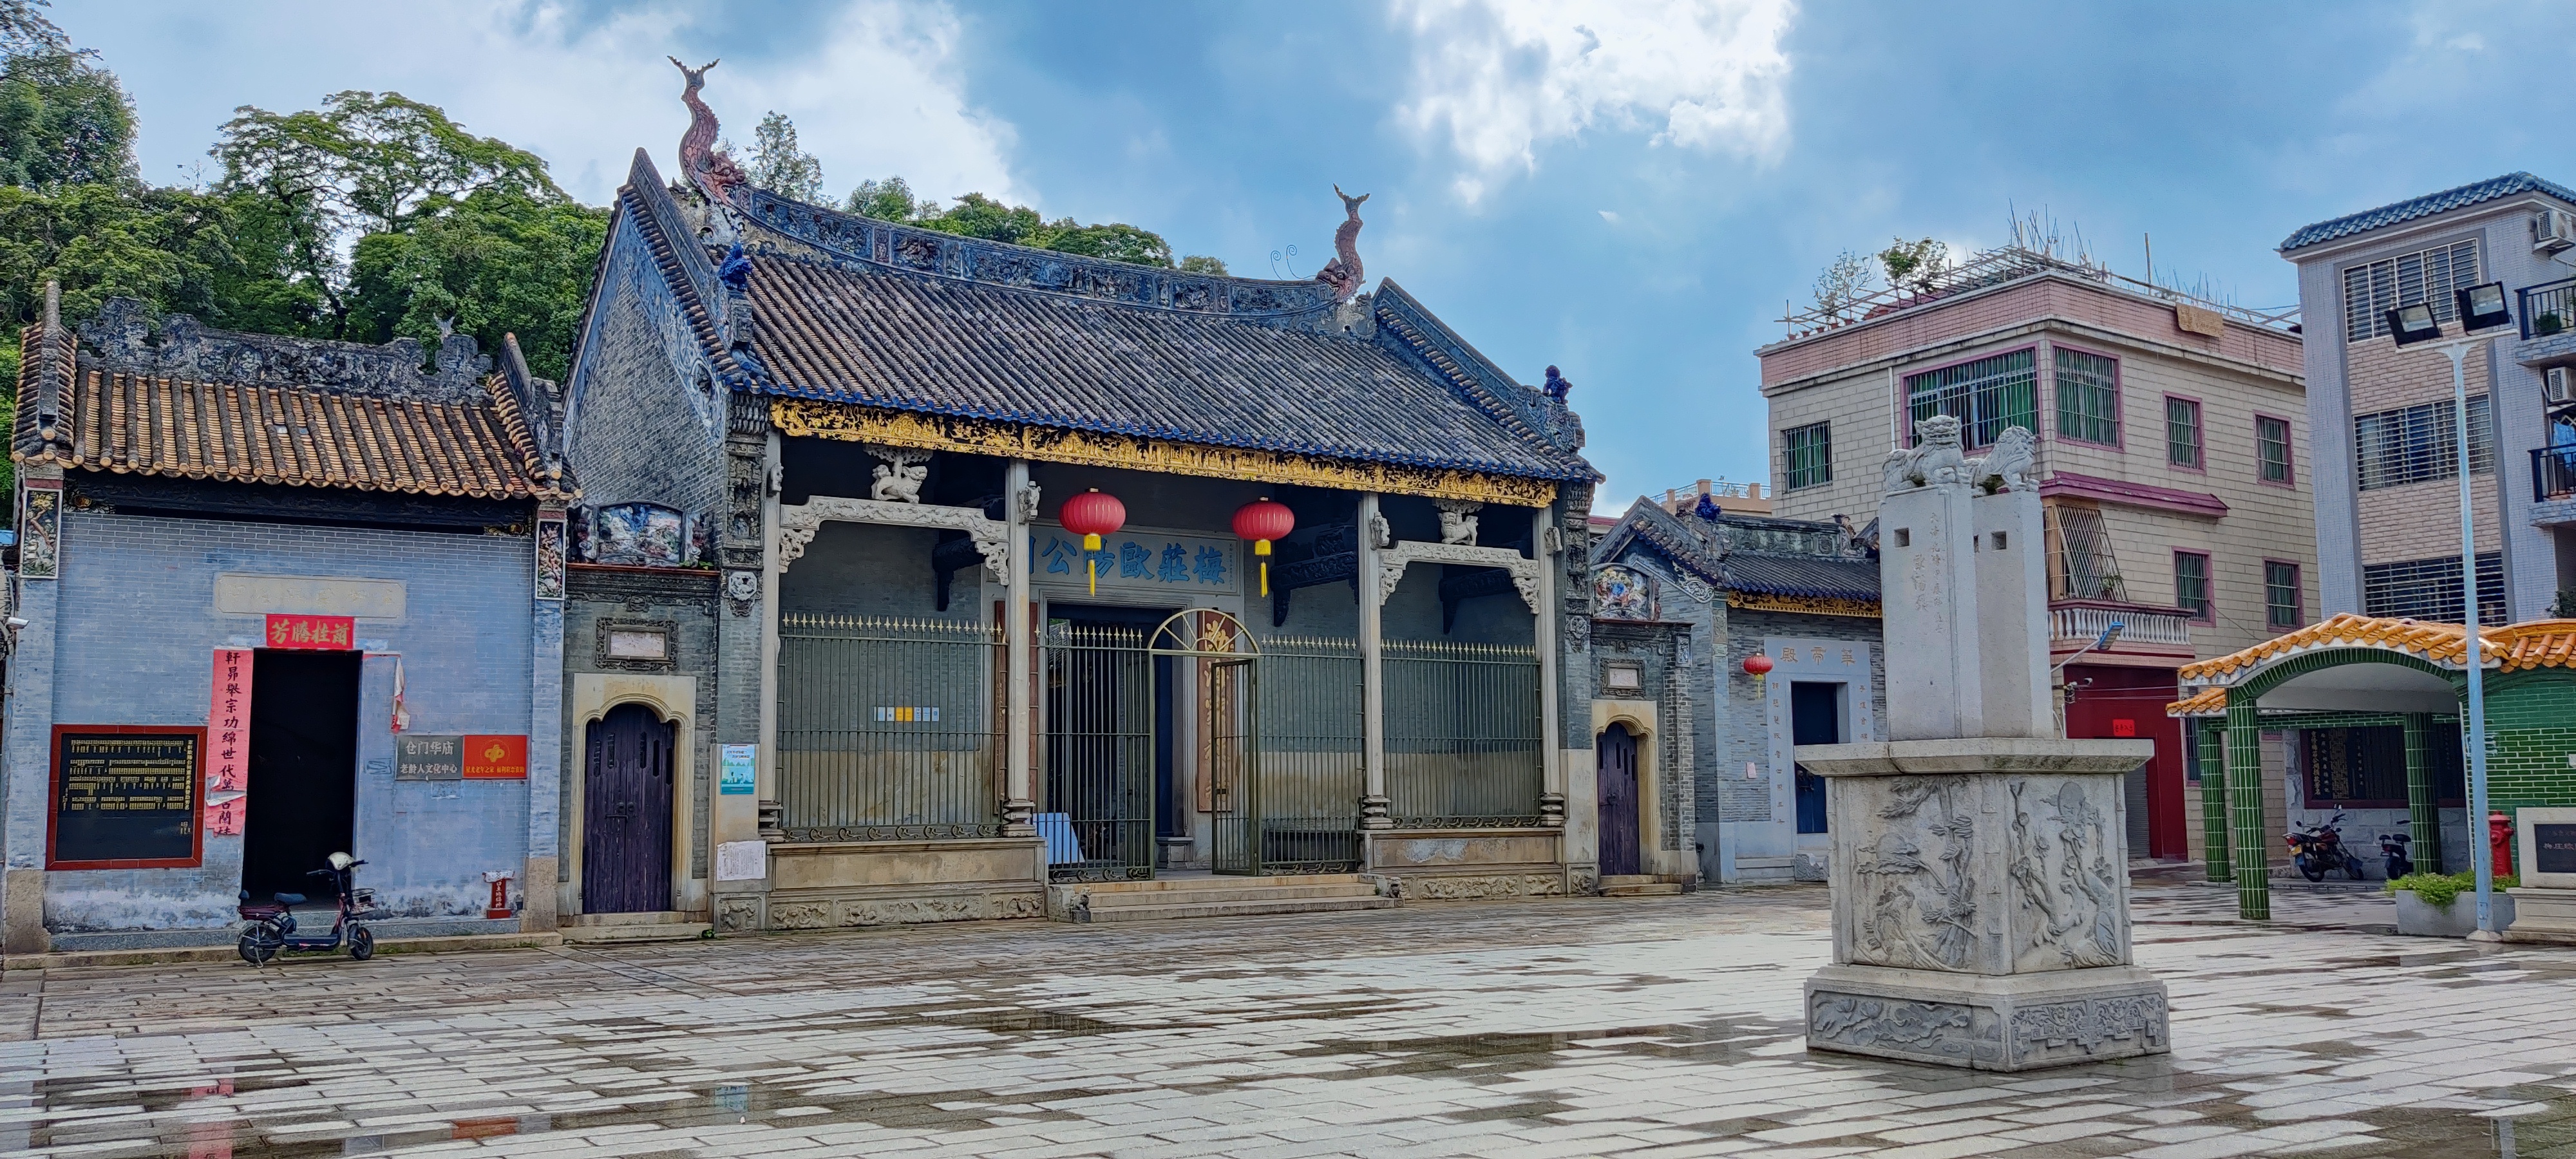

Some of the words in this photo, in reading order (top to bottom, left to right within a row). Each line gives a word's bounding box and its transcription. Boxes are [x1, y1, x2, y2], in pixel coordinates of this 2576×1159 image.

[1029, 535, 1227, 585] 梅莊歐陽公
[406, 740, 454, 755] 仓门华庙
[399, 762, 458, 775] 老龄人文化中心
